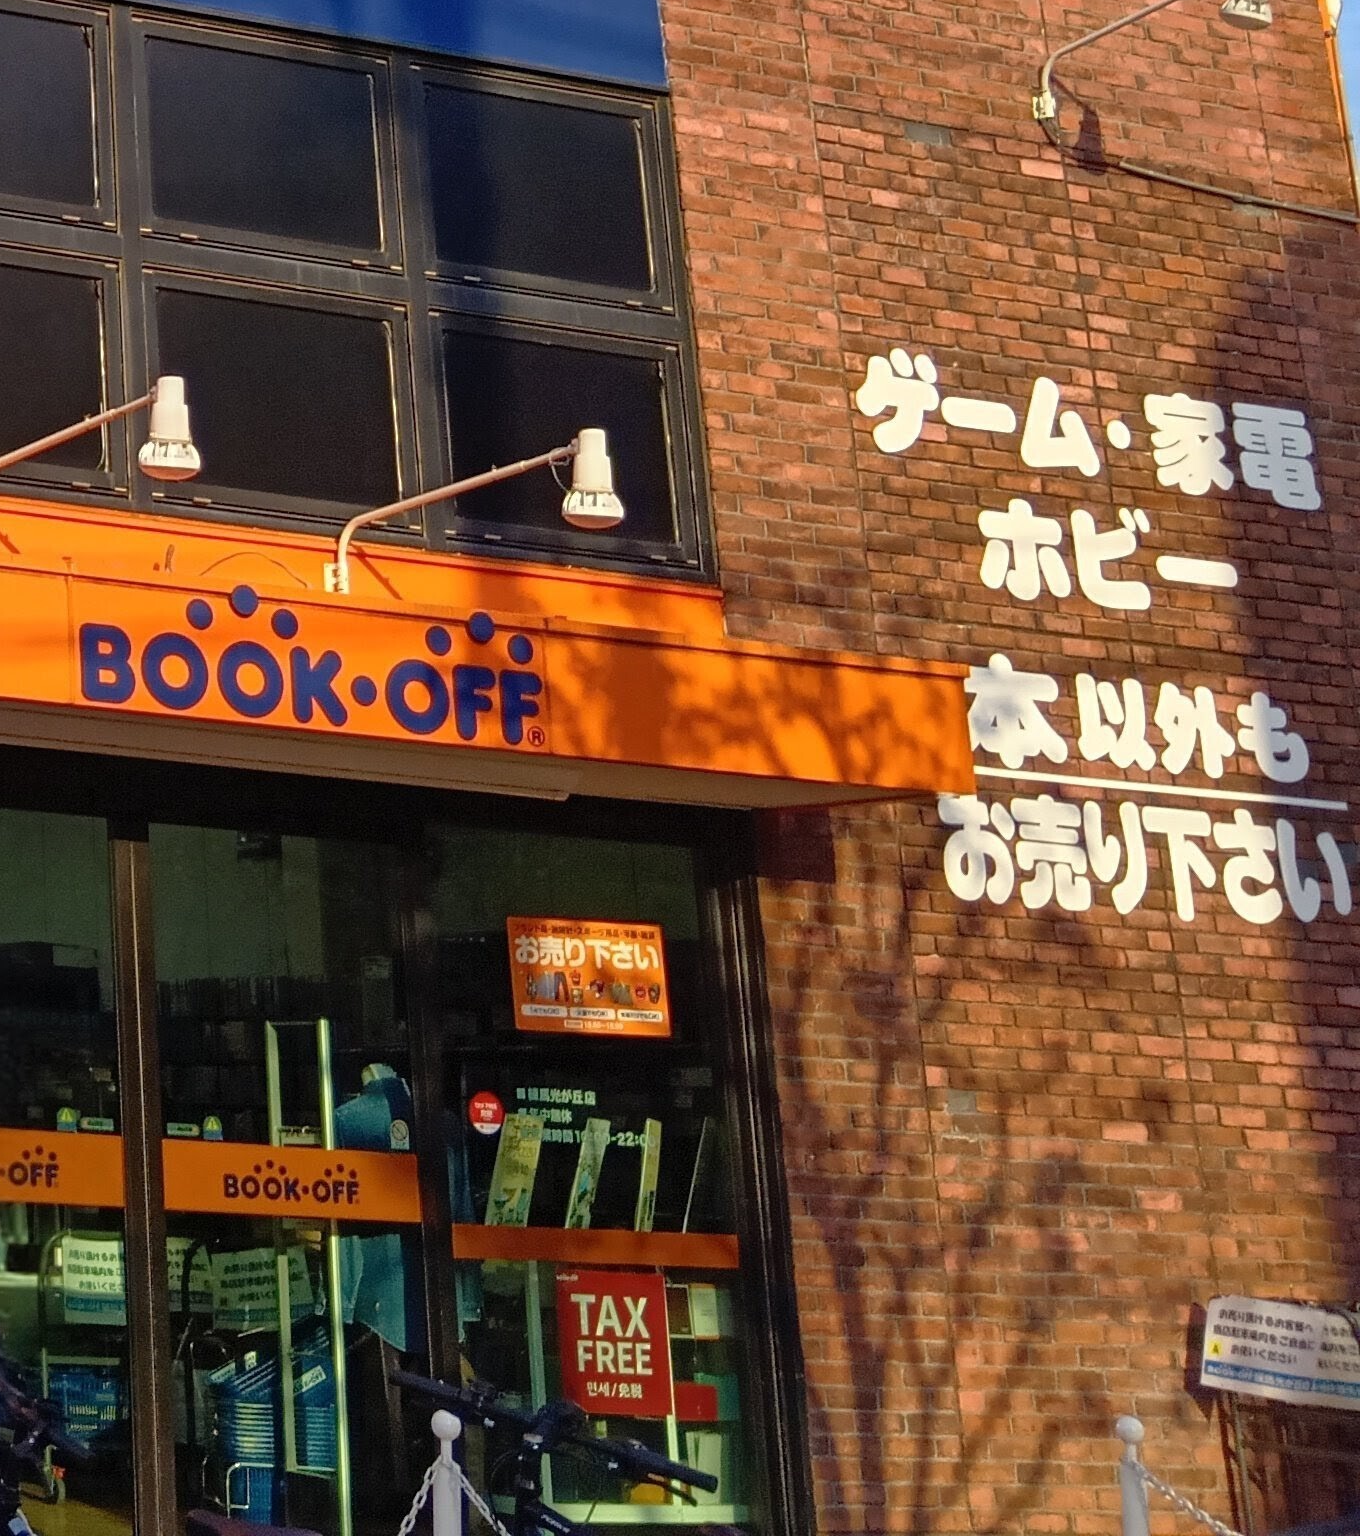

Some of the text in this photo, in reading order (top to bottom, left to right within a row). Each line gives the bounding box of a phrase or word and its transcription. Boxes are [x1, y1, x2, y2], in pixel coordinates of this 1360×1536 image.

[855, 348, 1322, 512] ゲーム・家電
[977, 498, 1239, 611] ホビー
[965, 652, 1311, 783] 本以外も
[937, 794, 1353, 924] お売り下さい
[514, 934, 660, 970] お売り下さい
[570, 1293, 651, 1339] TAX
[576, 1339, 654, 1376] FREE
